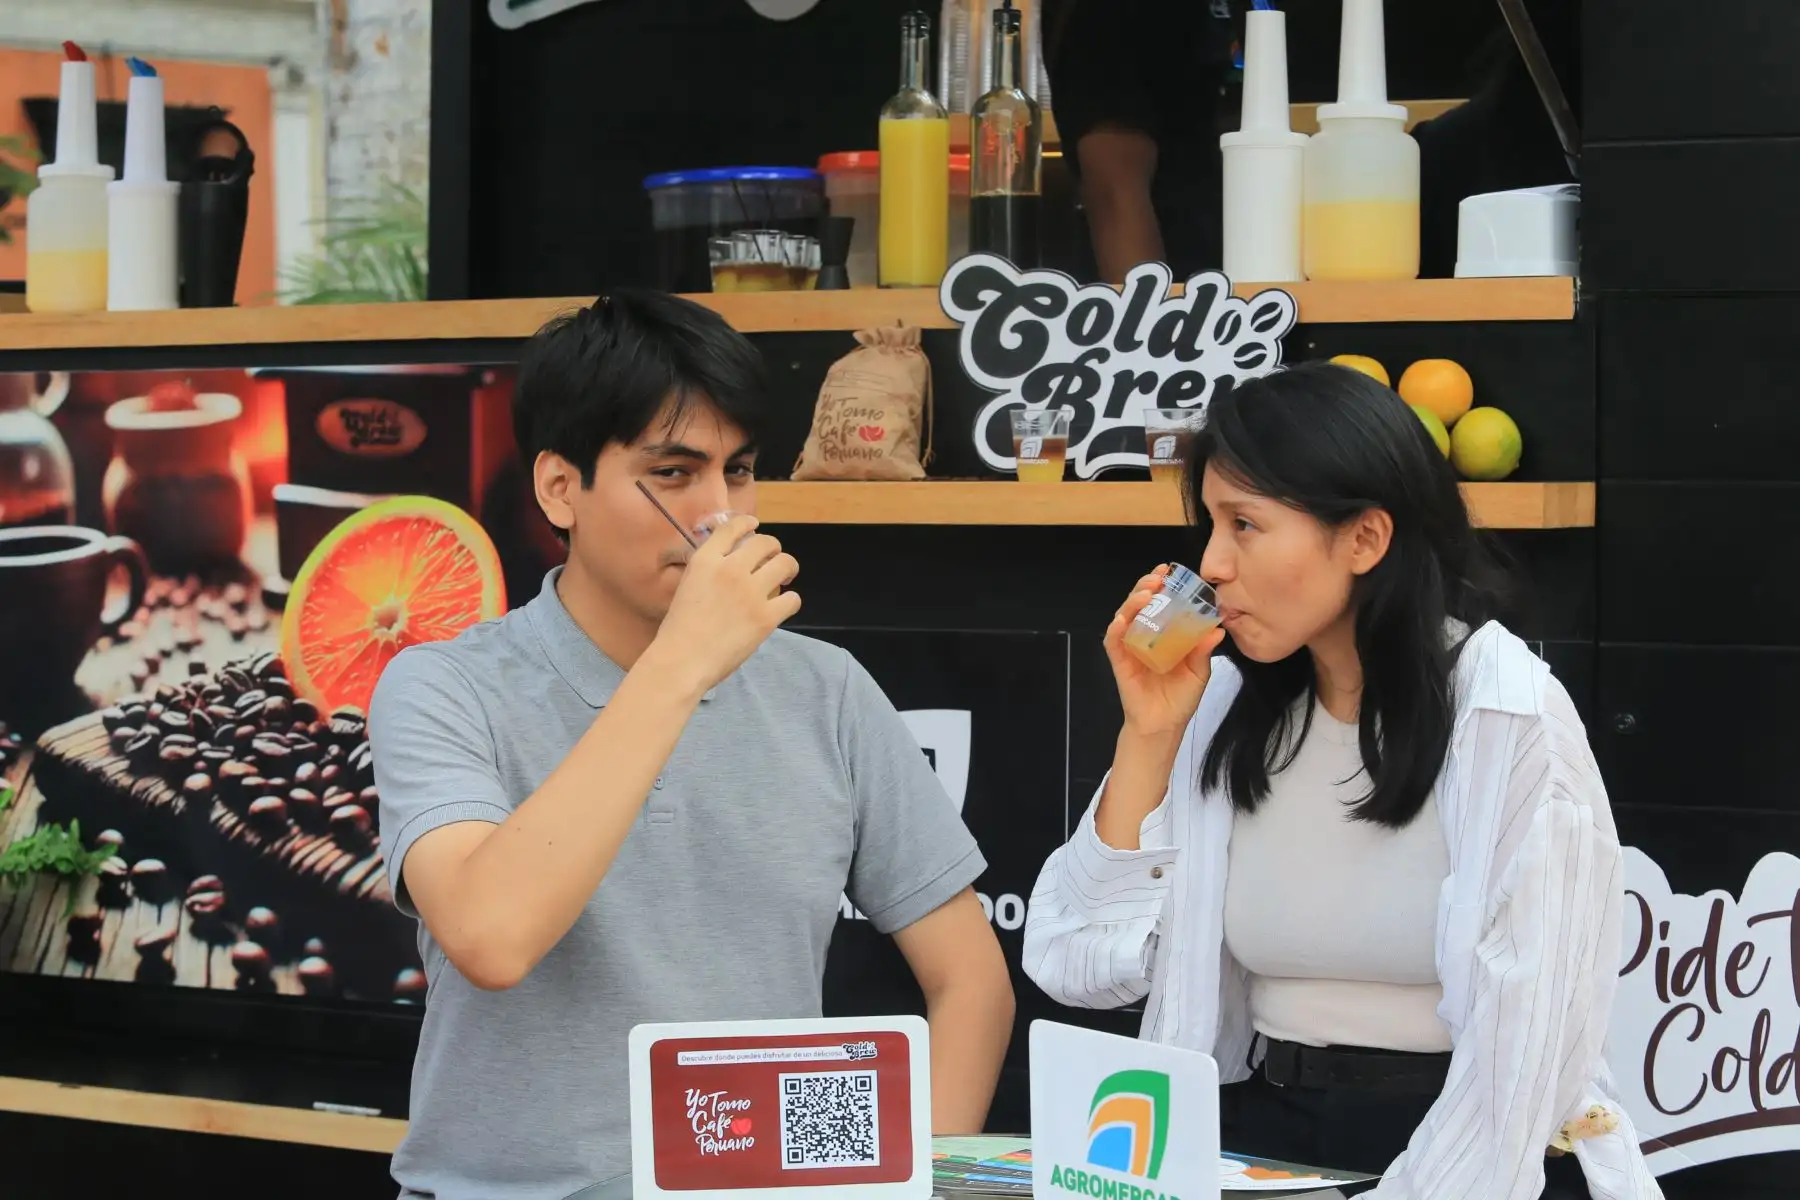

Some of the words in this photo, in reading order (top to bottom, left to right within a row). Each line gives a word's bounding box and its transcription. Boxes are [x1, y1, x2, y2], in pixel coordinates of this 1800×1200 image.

[951, 265, 1218, 380] Cold
[736, 1052, 761, 1061] puedes
[762, 1051, 791, 1059] disfrutar
[813, 1050, 843, 1058] delicioso
[843, 1042, 868, 1054] Cold
[850, 1049, 877, 1060] Brew
[1643, 1002, 1800, 1115] Cold
[684, 1088, 709, 1118] Yo
[708, 1091, 751, 1117] Tomo
[692, 1110, 734, 1139] Café
[695, 1133, 755, 1156] Peruano
[1050, 1164, 1181, 1200] AGROMER
